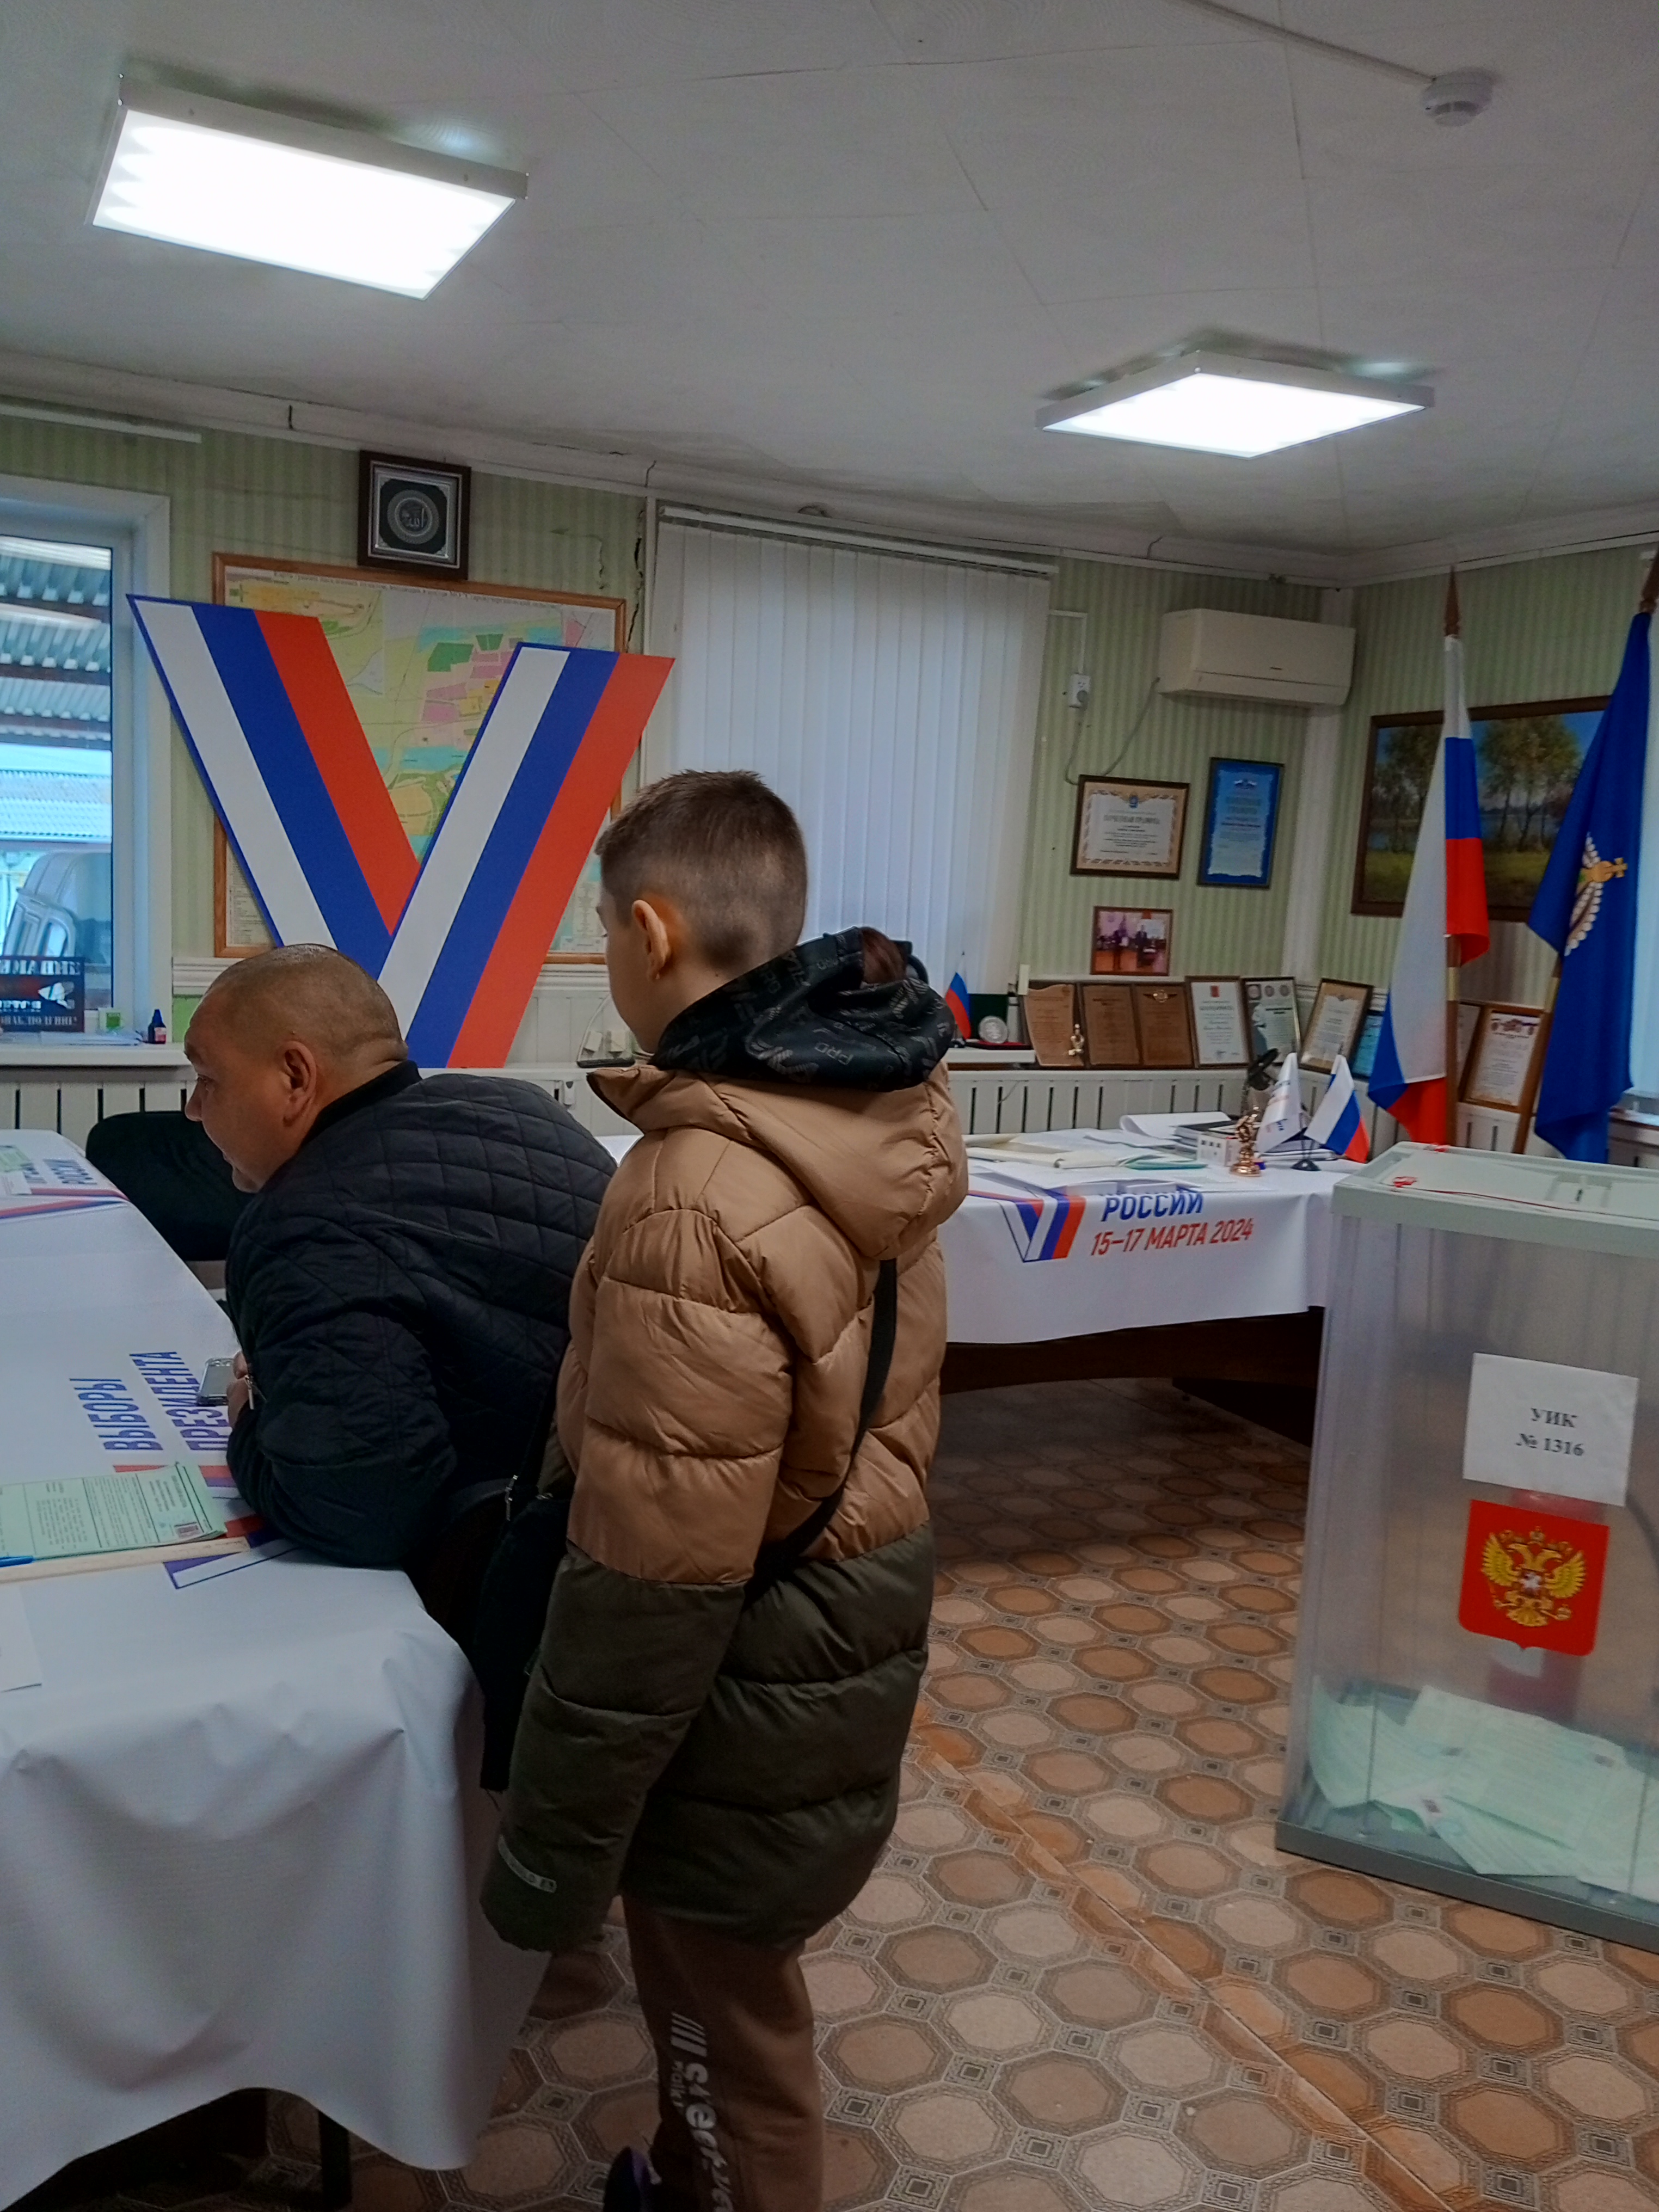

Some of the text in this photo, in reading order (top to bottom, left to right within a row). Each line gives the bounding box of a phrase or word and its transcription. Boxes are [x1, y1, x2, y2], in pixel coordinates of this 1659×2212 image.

[1101, 1191, 1204, 1222] РОССИИ
[1144, 1222, 1208, 1251] МАРТА
[1209, 1217, 1254, 1244] 2024
[69, 1378, 163, 1451] ВЫБОРЫ
[129, 1351, 231, 1451] ПРЕЗИДЕНТА
[1531, 1408, 1578, 1428] УИК
[1543, 1437, 1585, 1457] 1316
